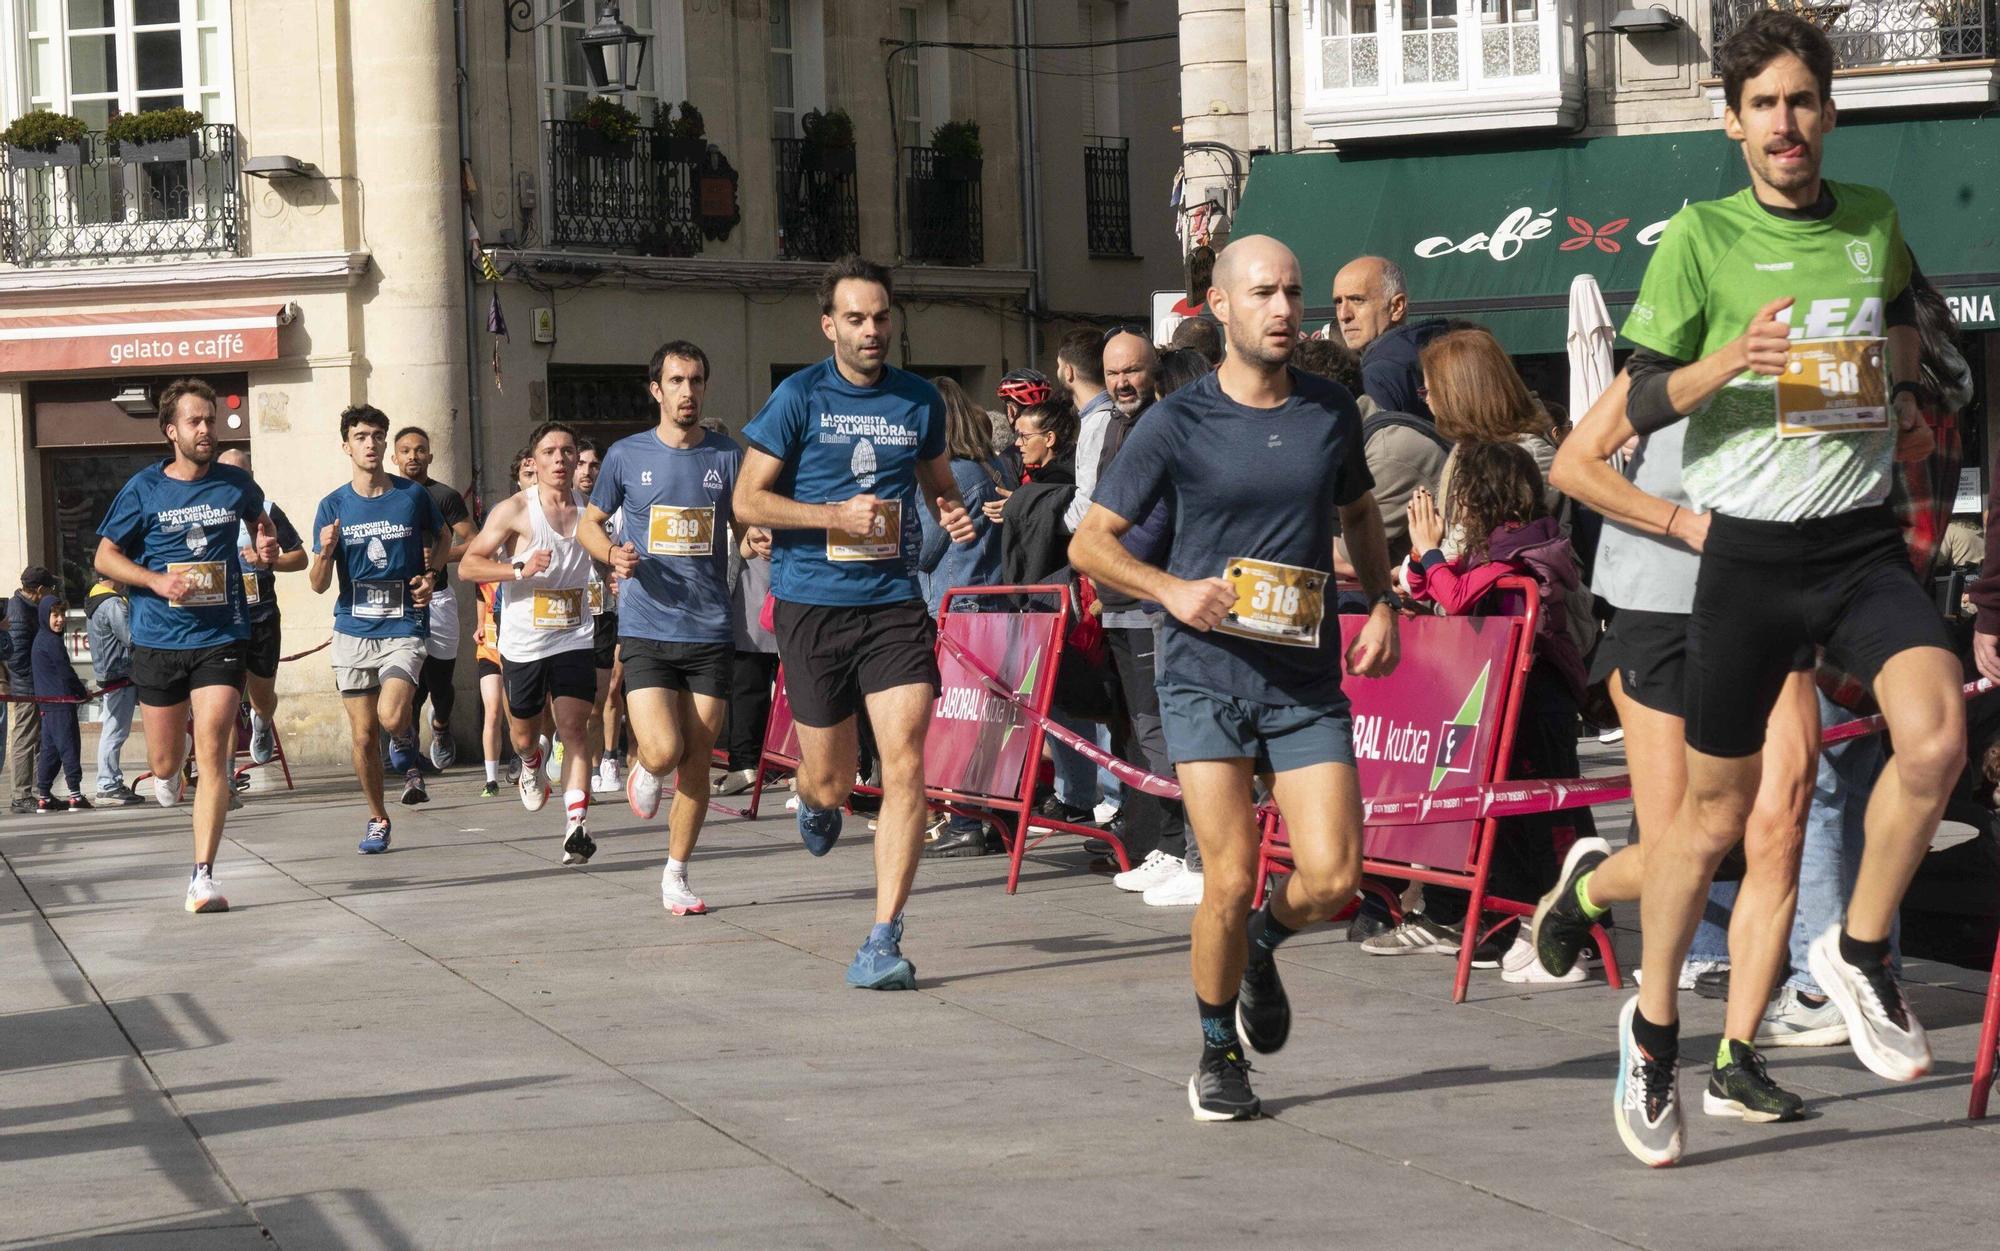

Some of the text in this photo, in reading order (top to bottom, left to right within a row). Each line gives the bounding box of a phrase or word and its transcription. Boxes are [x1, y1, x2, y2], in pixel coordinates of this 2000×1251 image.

[1414, 206, 1557, 261] café
[110, 333, 244, 364] gelato e caffé
[1818, 361, 1860, 397] 58
[820, 413, 888, 425] LA CONQUISTA
[836, 423, 907, 437] ALMENDRA
[874, 436, 918, 446] KONKISTA
[168, 504, 212, 517] CONQUISTA
[171, 507, 228, 525] ALMENDRA
[202, 515, 237, 527] KONKISTA
[350, 520, 390, 531] CONQUISTA
[667, 518, 699, 537] 389
[353, 524, 405, 539] ALMENDRA
[381, 531, 412, 541] KONKISTA
[367, 589, 390, 604] 801
[1251, 581, 1300, 615] 318
[547, 598, 573, 614] 294
[936, 682, 981, 721] LABORAL
[1384, 720, 1430, 764] kutxa
